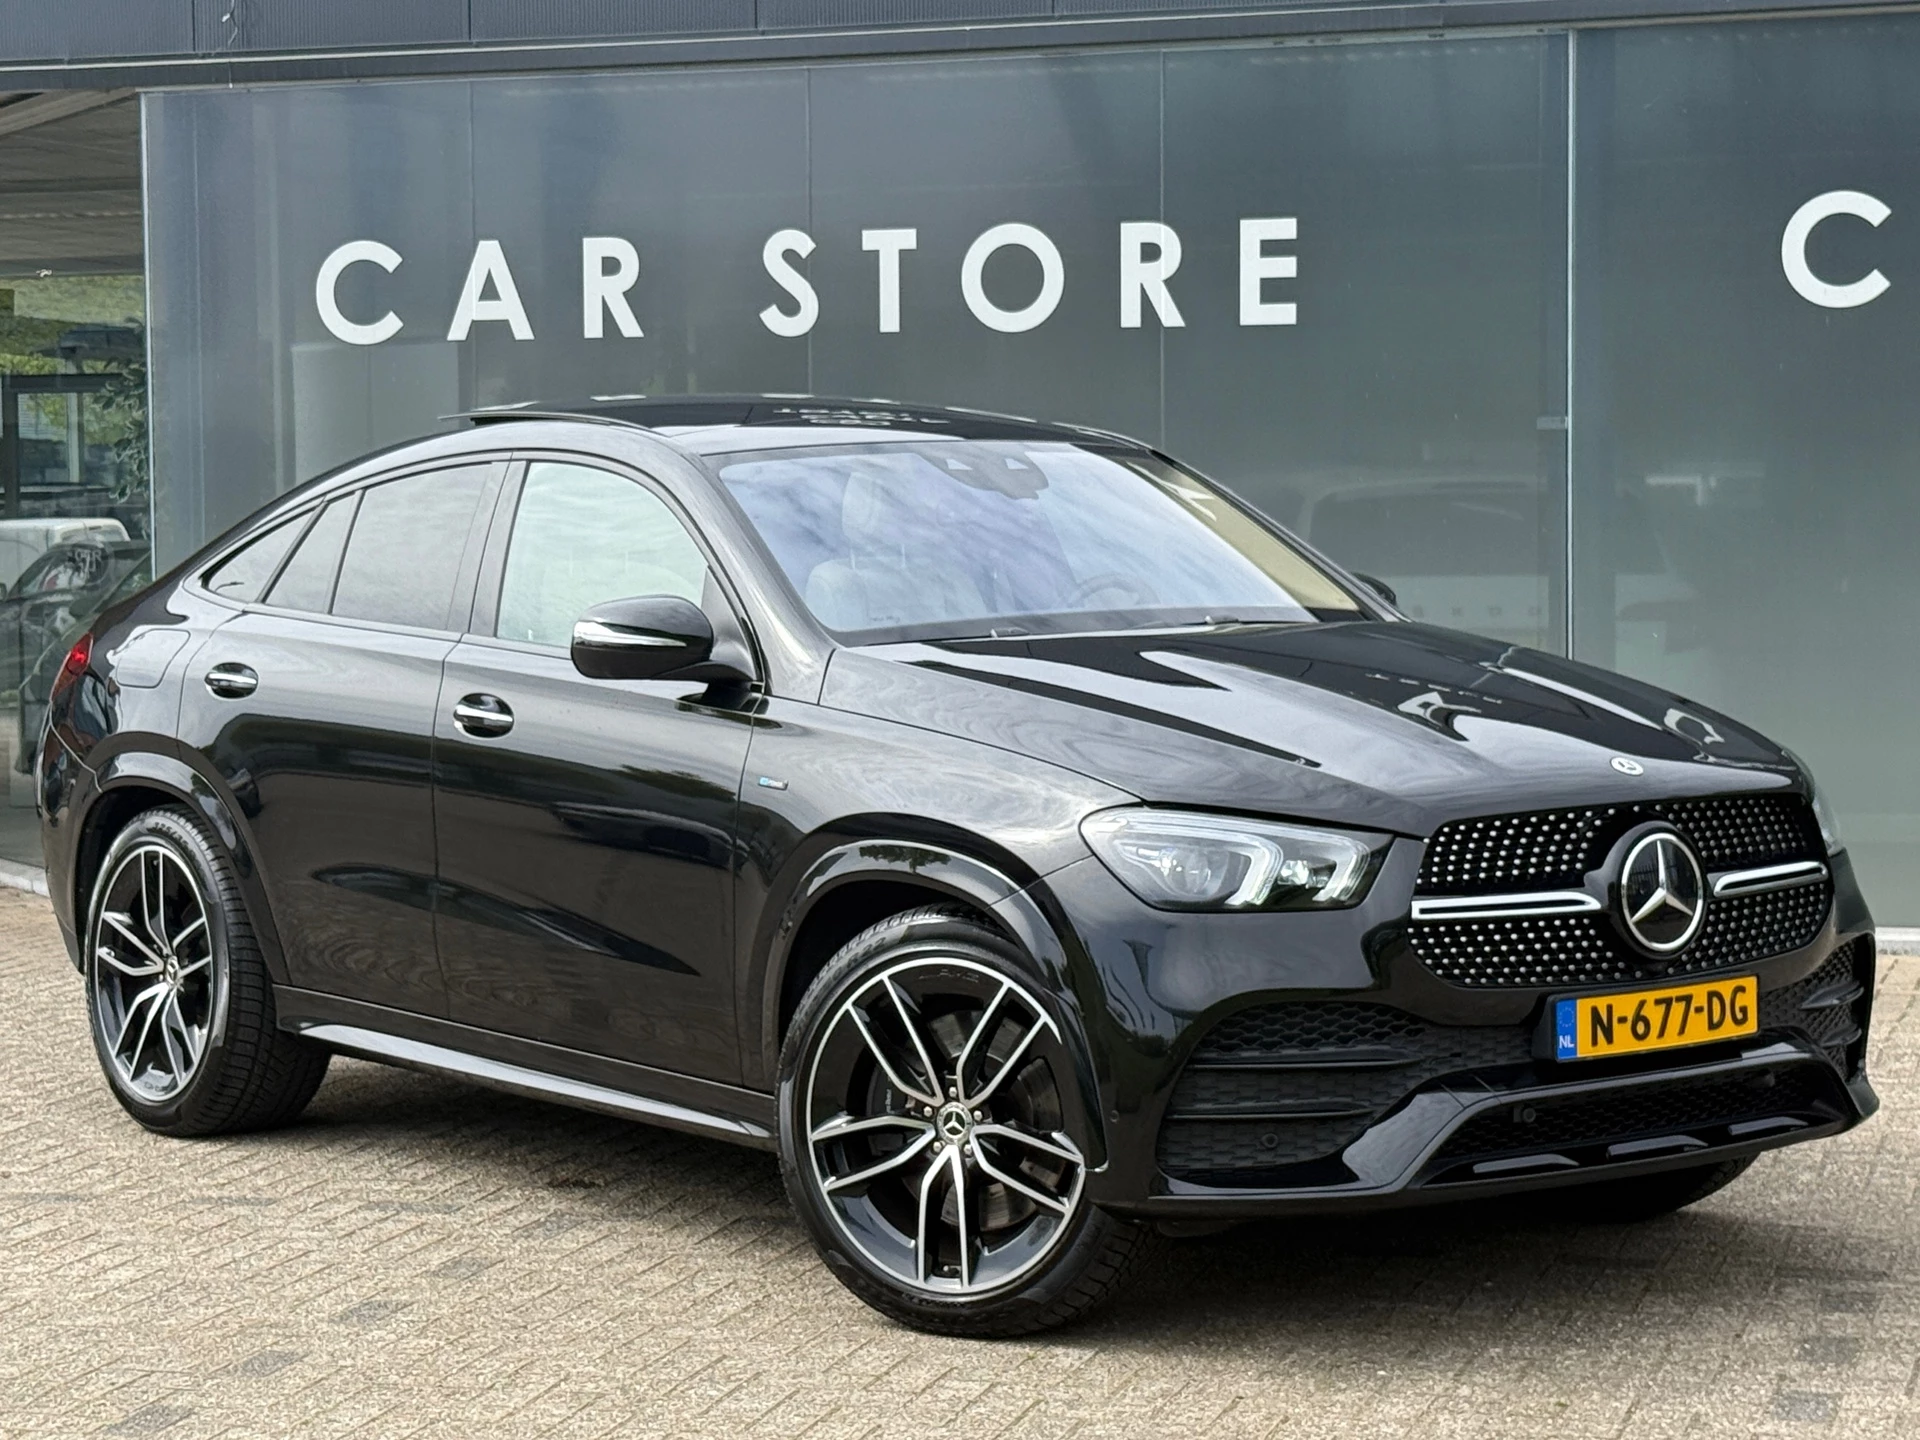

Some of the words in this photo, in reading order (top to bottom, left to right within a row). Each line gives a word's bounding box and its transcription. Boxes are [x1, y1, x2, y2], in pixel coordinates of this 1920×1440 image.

[316, 237, 643, 344] CAR
[760, 218, 1296, 336] STORE
[1782, 191, 1891, 307] C
[1558, 1035, 1575, 1050] NL
[1591, 985, 1748, 1047] N-677-DG
